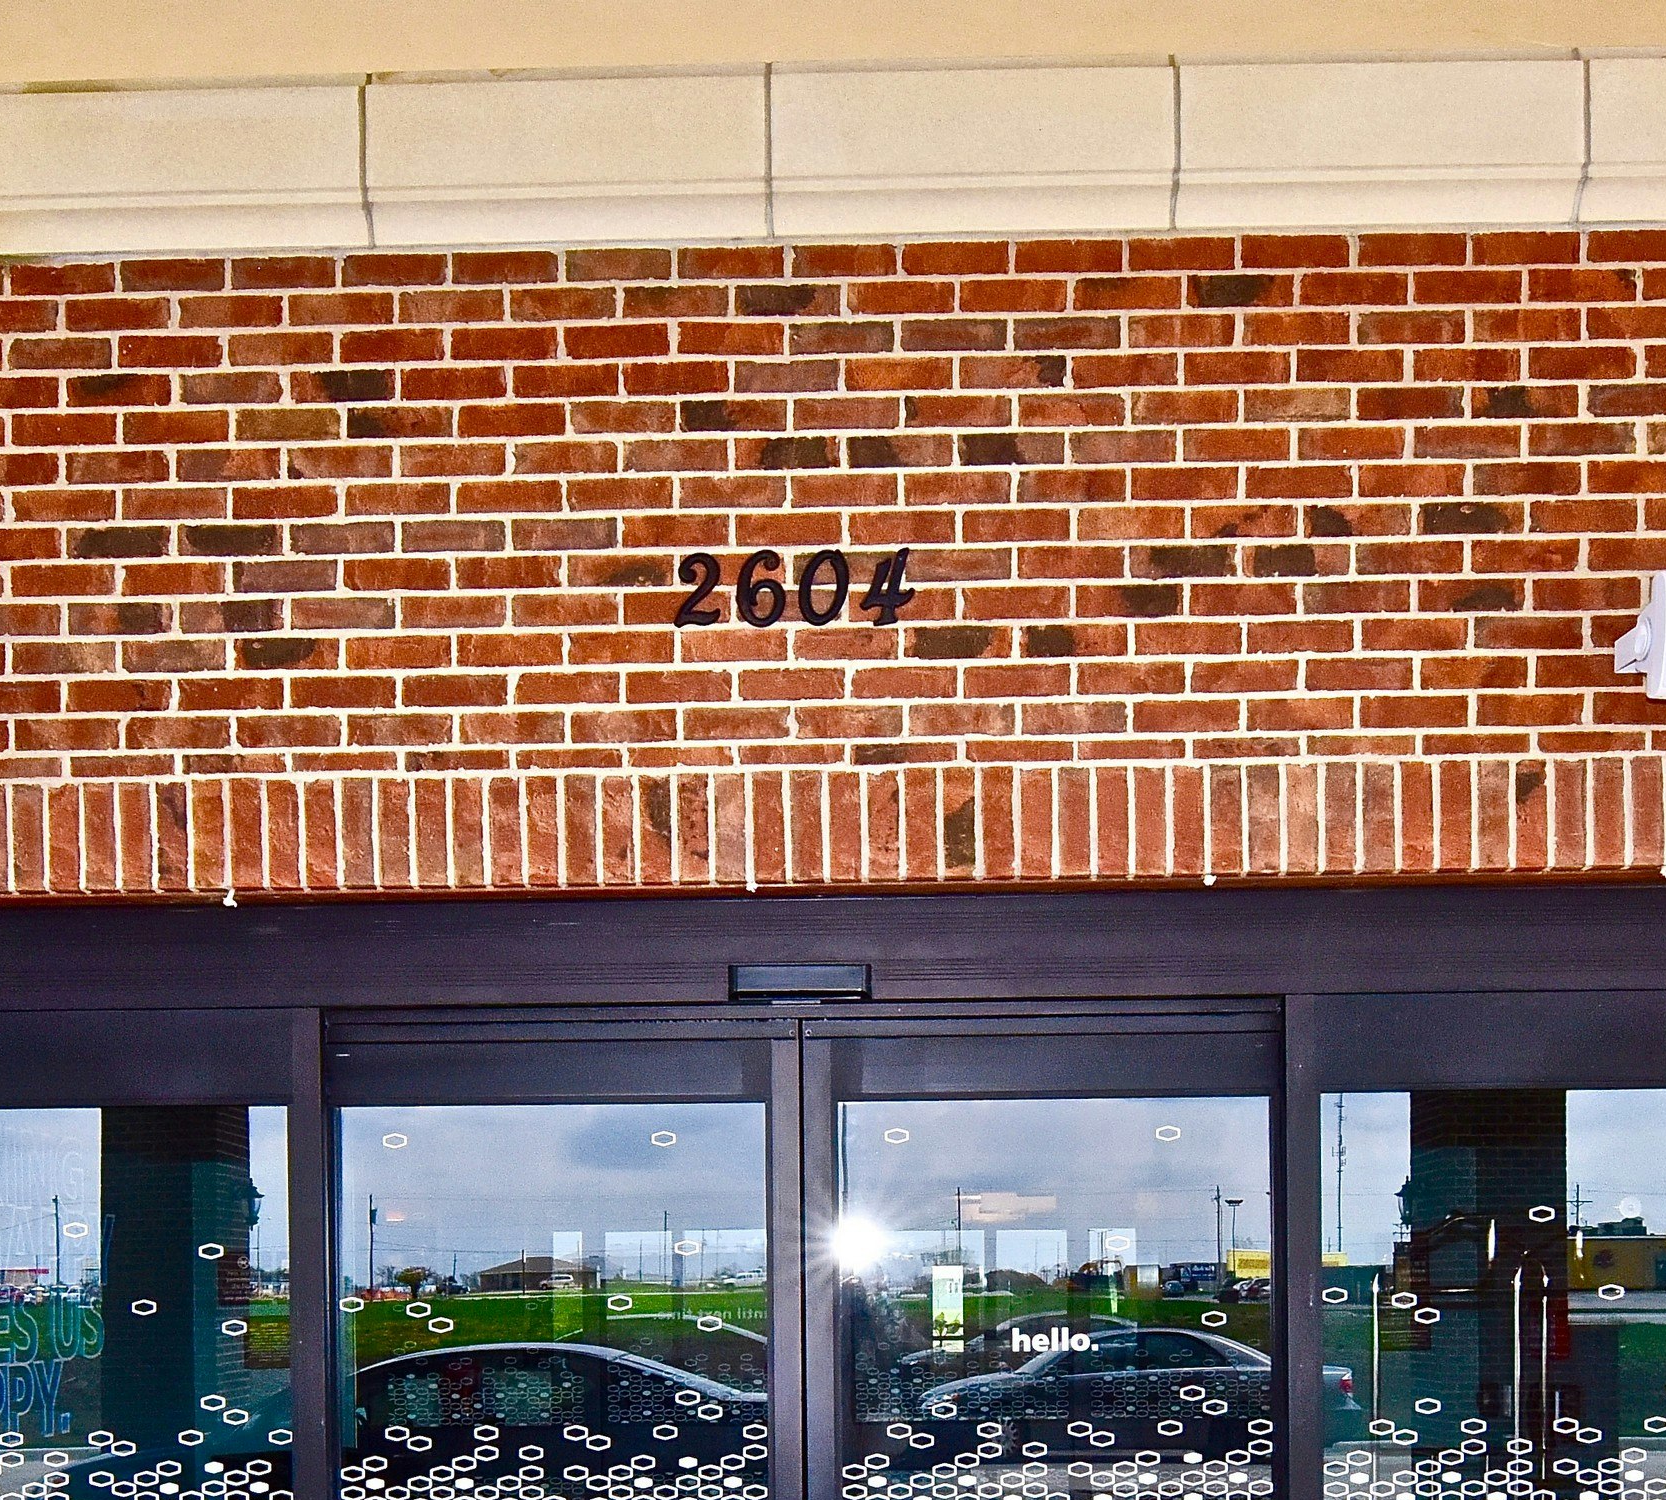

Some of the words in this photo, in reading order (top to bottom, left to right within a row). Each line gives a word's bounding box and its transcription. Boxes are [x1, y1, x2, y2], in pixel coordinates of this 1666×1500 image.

[673, 548, 915, 628] 2604
[51, 1290, 106, 1361] US
[1011, 1326, 1099, 1353] hello.
